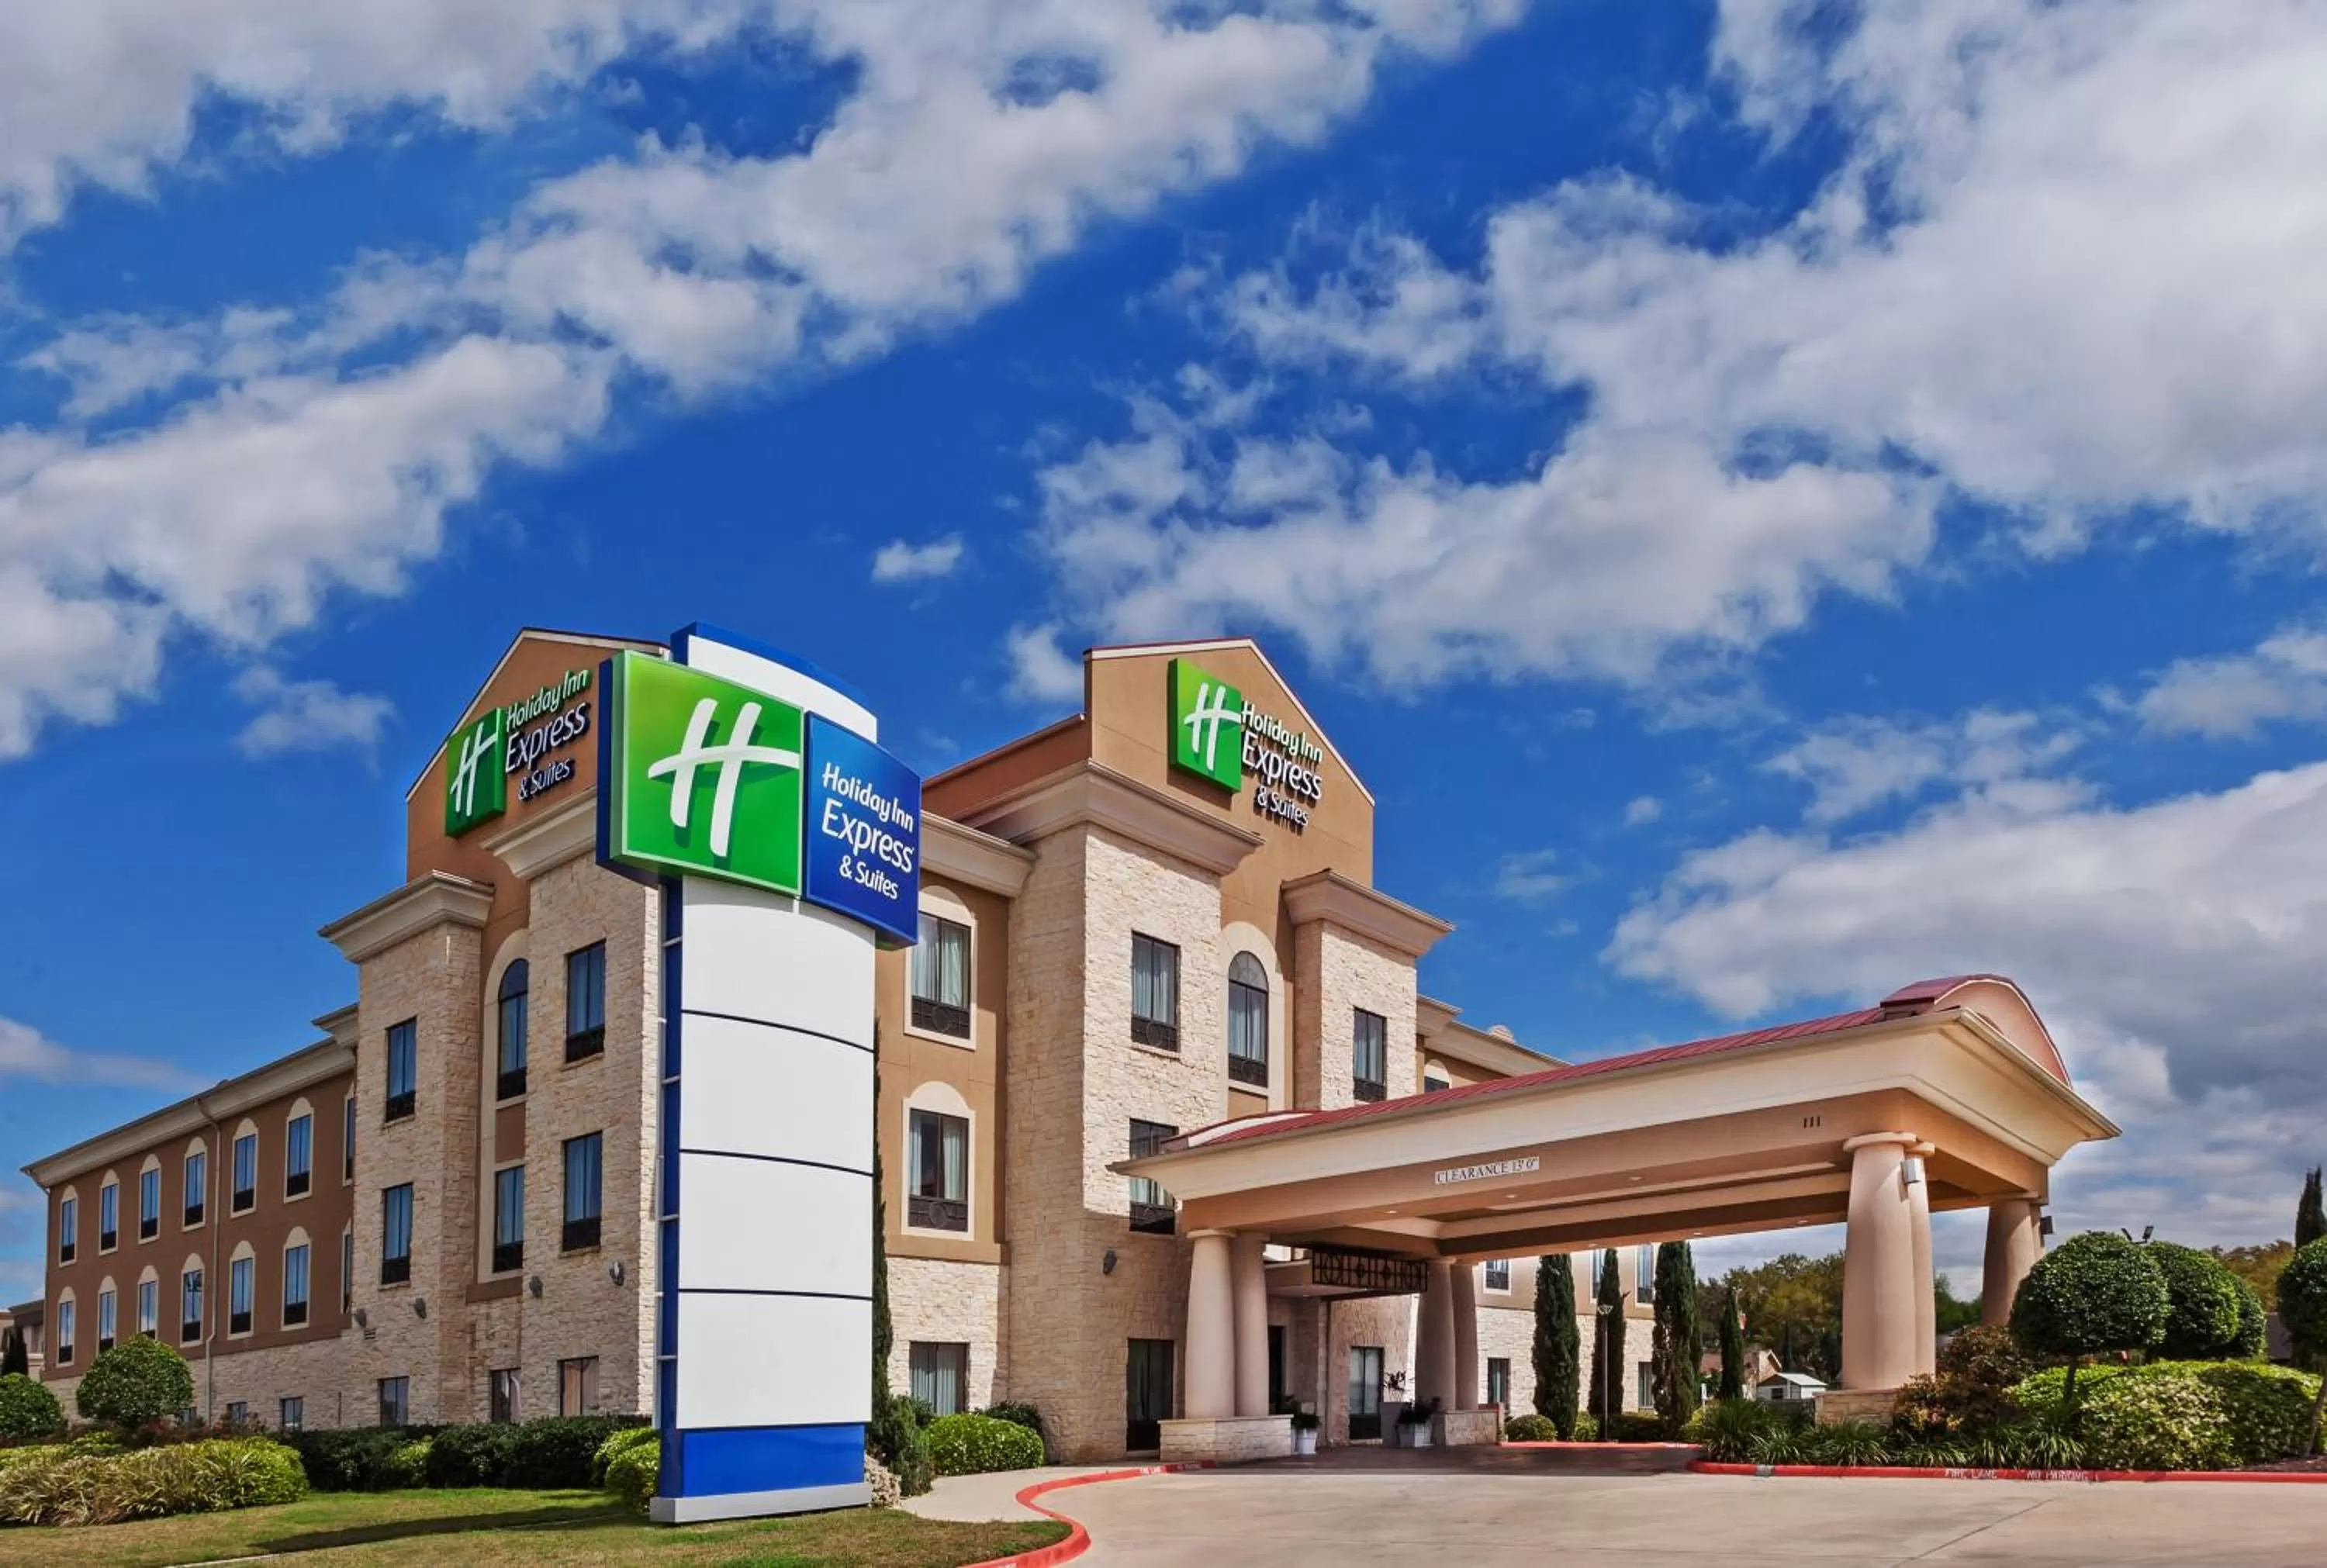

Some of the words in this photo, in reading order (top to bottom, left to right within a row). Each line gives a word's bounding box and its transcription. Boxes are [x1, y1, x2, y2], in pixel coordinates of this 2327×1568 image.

[507, 687, 560, 731] Holiday
[562, 669, 589, 698] Inn
[1184, 682, 1241, 771] H
[1242, 700, 1298, 755] Holiday
[1301, 731, 1323, 763] Inn
[505, 702, 587, 773] Express
[1242, 730, 1322, 800] Express
[518, 776, 528, 800] &
[531, 757, 570, 795] Suites
[648, 698, 800, 856] H
[822, 762, 890, 823] Holiday
[891, 797, 914, 833] Inn
[1257, 786, 1267, 806] &
[1271, 792, 1308, 826] Suites
[821, 797, 914, 874] Express
[839, 855, 852, 879] &
[857, 862, 898, 900] Suites
[1437, 1162, 1508, 1183] CLEARANCE
